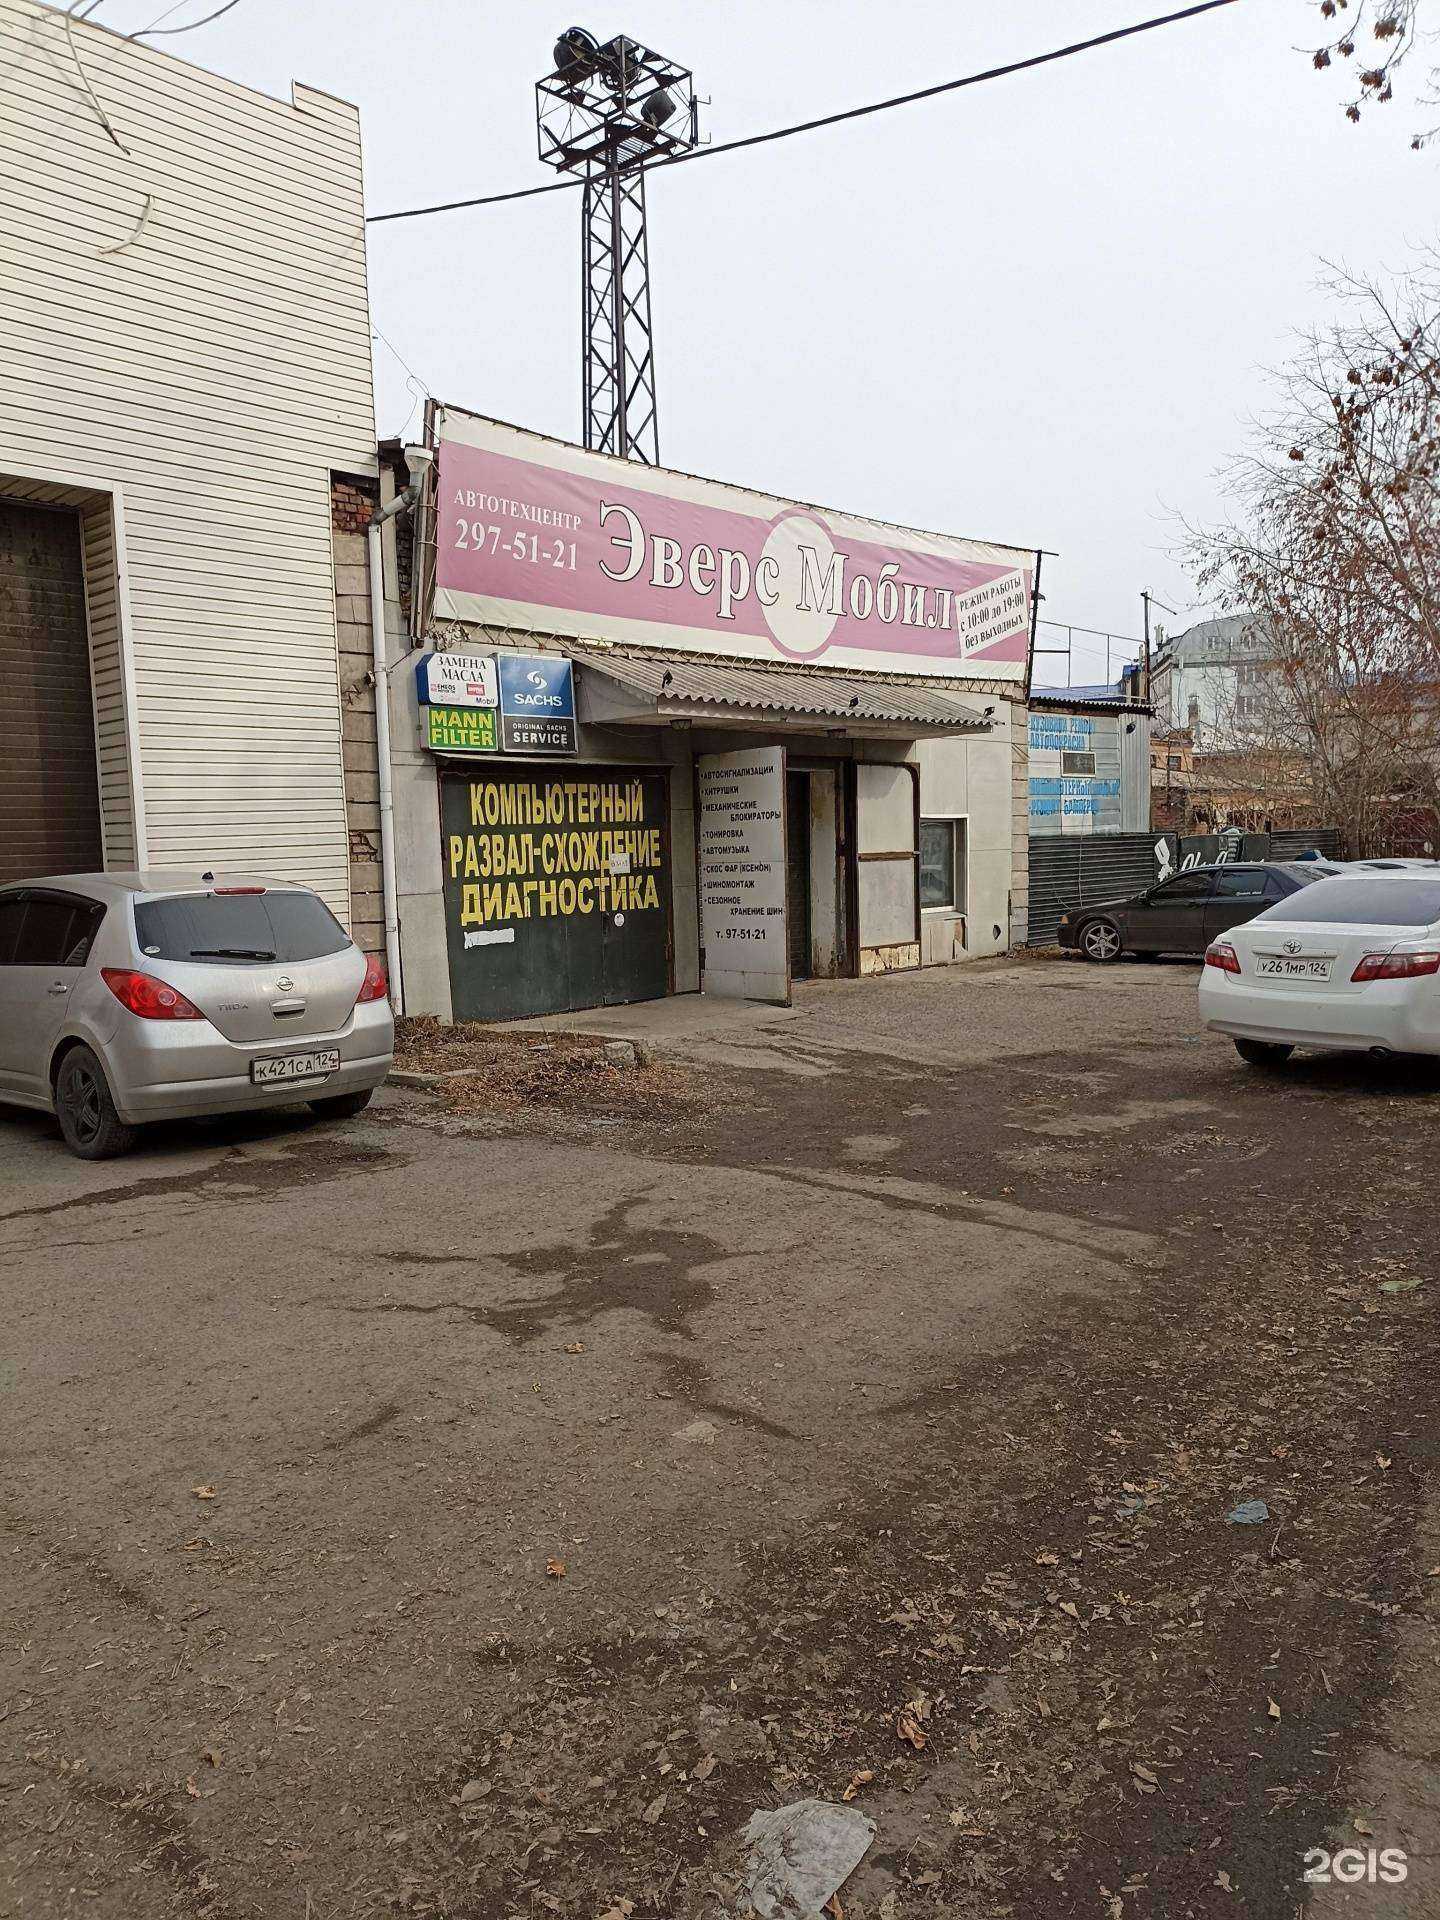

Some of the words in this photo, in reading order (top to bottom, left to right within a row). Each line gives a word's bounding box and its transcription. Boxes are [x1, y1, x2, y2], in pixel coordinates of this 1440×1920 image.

[453, 489, 583, 531] АВТОТЕХЦЕНТР
[455, 518, 578, 571] 297-51-21
[599, 500, 780, 619] Эверс
[796, 545, 954, 630] Мобил
[960, 590, 989, 612] РЕЖИМ
[990, 576, 1021, 598] РАБОТЫ
[967, 607, 990, 629] 10:00
[991, 605, 1001, 619] до
[1003, 591, 1024, 613] 19:00
[965, 634, 979, 649] без
[437, 656, 486, 669] ЗАМЕНА
[442, 668, 484, 682] МАСЛА
[514, 693, 563, 707] SACHS
[431, 710, 492, 729] MANN
[512, 722, 544, 731] ORIGINAL
[546, 724, 567, 732] SACHS
[431, 728, 494, 746] FILTER
[513, 732, 568, 745] SERVICE
[703, 766, 774, 780] АВТОСИГНАЛИЗАЦИИ
[470, 779, 644, 826] КОМПЬЮТЕРНЫЙ
[705, 801, 758, 812] МЕХАНИЧЕСКИЕ
[730, 811, 781, 822] БЛОКИРАТОРЫ
[705, 830, 744, 839] ТОНИРОВКА
[450, 830, 661, 878] РАЗВАЛ-СХОЖДЕНИЕ
[706, 846, 750, 855] АВТОМУЗЫКА
[724, 864, 738, 873] ФАР
[740, 863, 771, 874] (КСЕНОН)
[706, 880, 755, 889] ШИНОМОНТАЖ
[461, 875, 660, 927] ДИАГНОСТИКА
[707, 897, 741, 905] СЕЗОННОЕ
[730, 907, 764, 916] ХРАНЕНИЕ
[766, 907, 783, 916] ШИН
[725, 929, 766, 940] 97-51-21
[1308, 961, 1327, 974] 124
[259, 1059, 313, 1078] К421СА
[315, 1053, 336, 1066] 124
